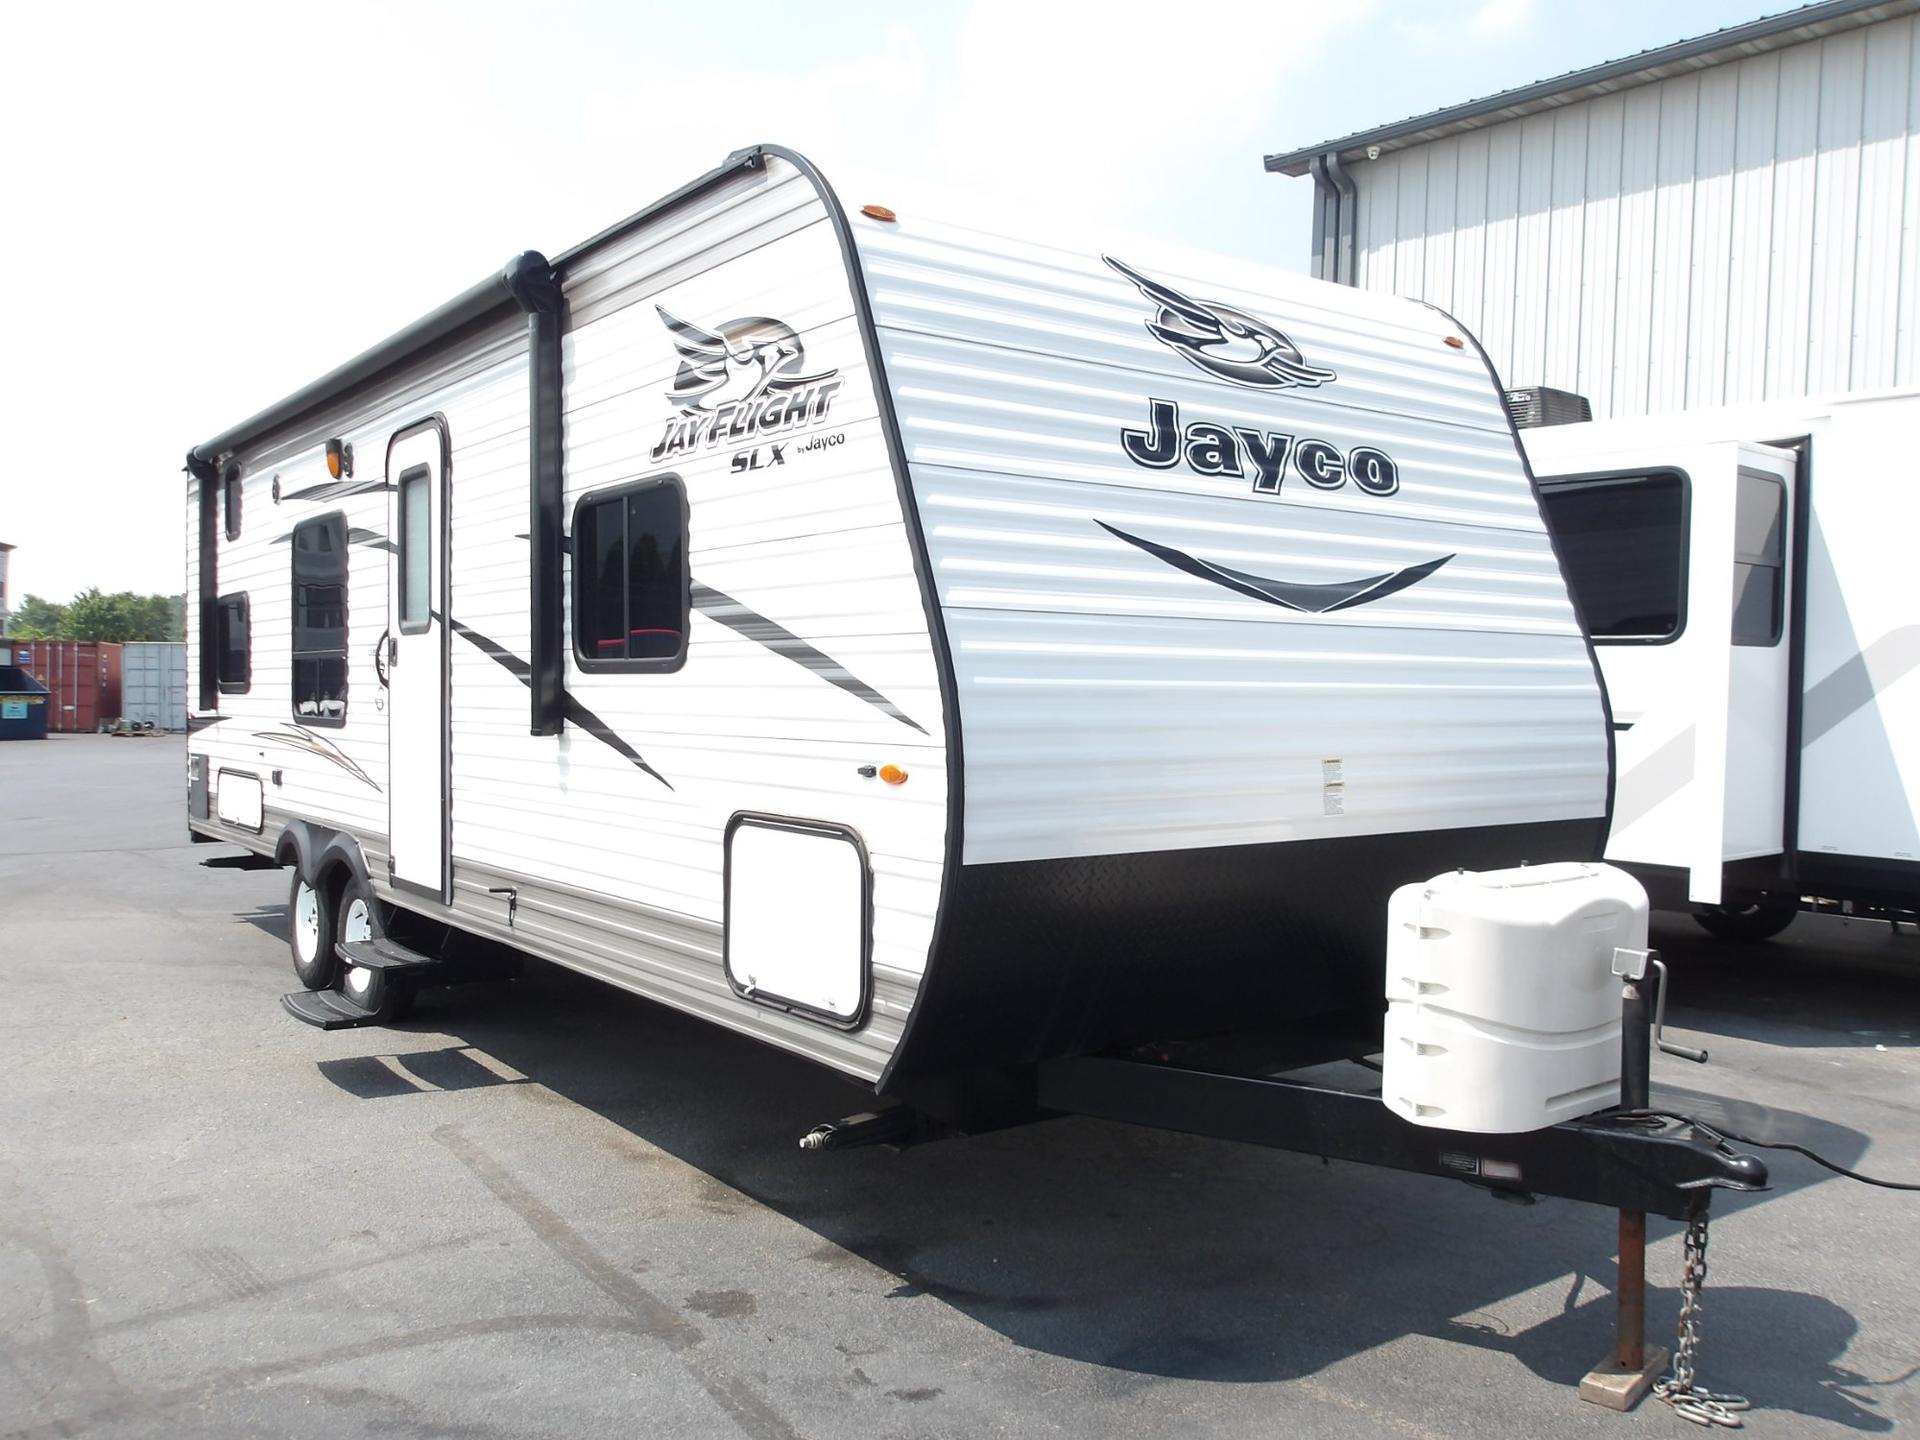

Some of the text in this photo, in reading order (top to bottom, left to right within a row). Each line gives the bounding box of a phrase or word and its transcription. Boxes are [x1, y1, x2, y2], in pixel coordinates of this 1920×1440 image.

[731, 442, 789, 474] SLX
[797, 433, 845, 455] by Jayco
[1121, 397, 1400, 497] Jayco
